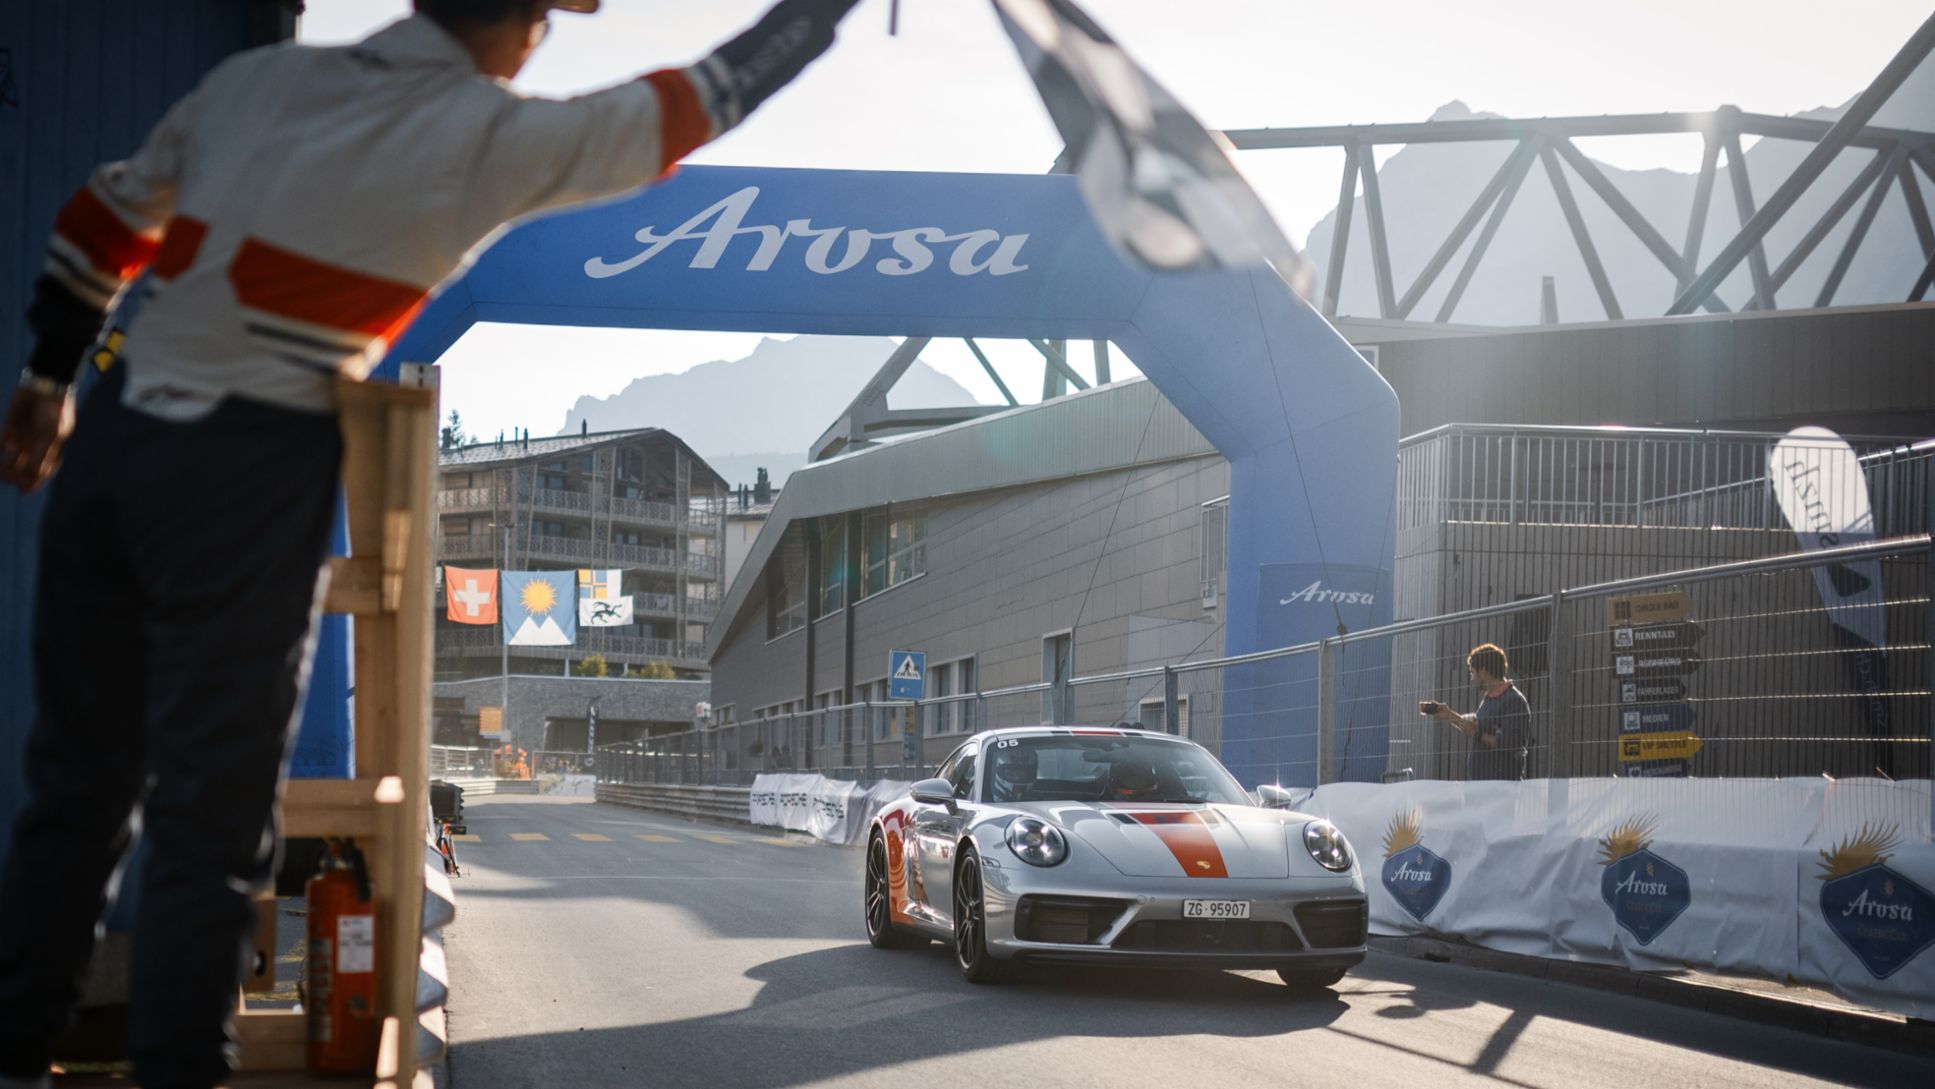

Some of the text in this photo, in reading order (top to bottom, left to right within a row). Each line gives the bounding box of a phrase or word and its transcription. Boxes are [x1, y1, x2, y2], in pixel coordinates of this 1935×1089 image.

[584, 186, 1030, 279] Arosa
[1280, 580, 1375, 605] Arosa
[1635, 630, 1676, 640] RENNTAXI
[1642, 714, 1669, 724] MEDIEN
[1390, 861, 1432, 882] Arosa
[1614, 870, 1668, 896] Arosa
[1210, 903, 1246, 917] 95907
[1842, 888, 1913, 921] Arosa
